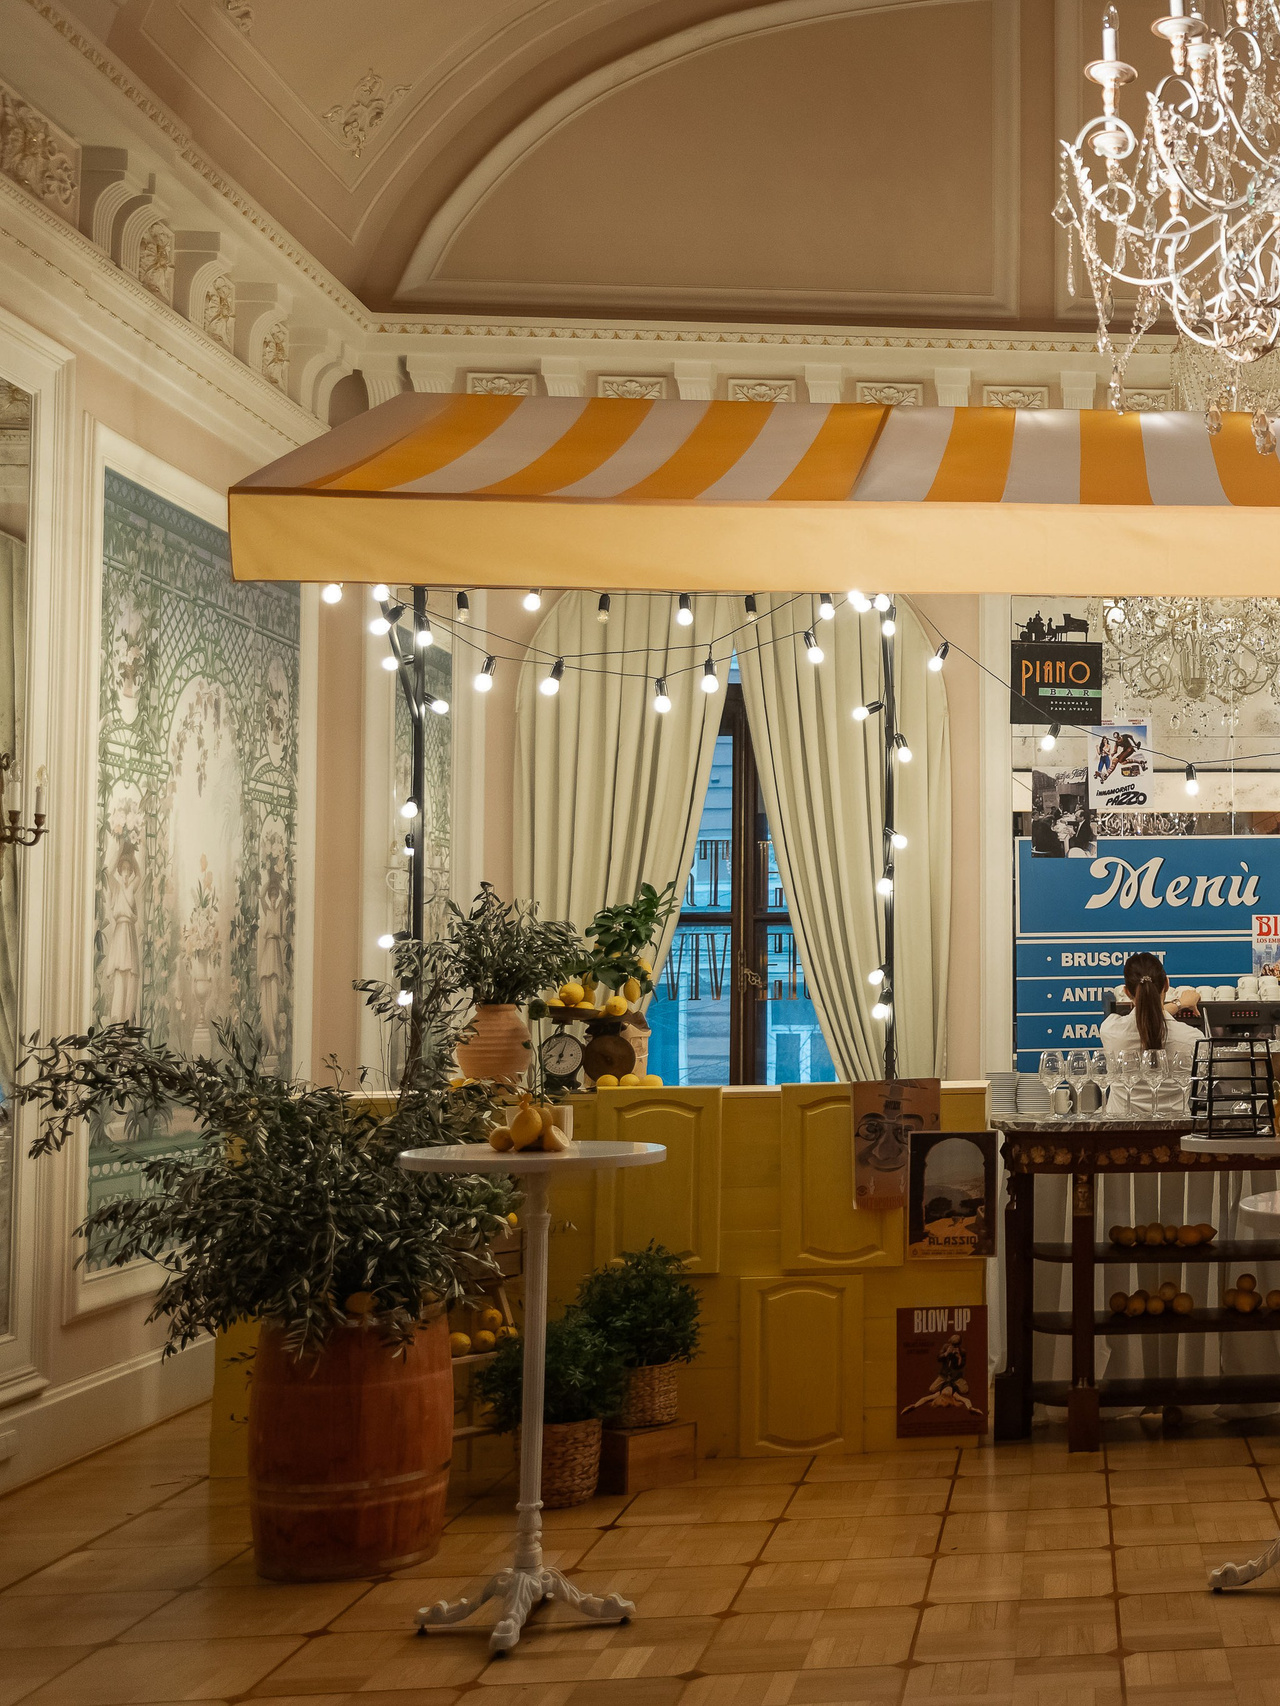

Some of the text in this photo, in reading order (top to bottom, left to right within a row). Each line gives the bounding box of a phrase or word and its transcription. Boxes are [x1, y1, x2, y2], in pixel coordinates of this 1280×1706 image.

[1021, 659, 1091, 697] PIANO
[1049, 688, 1090, 697] BAR
[1105, 791, 1147, 806] PAZZO
[1084, 856, 1261, 910] Menù
[1061, 987, 1115, 1002] ANTI
[1062, 1024, 1101, 1039] ARA
[928, 1235, 977, 1246] ALASSIO
[913, 1308, 971, 1334] BLOW-UP
